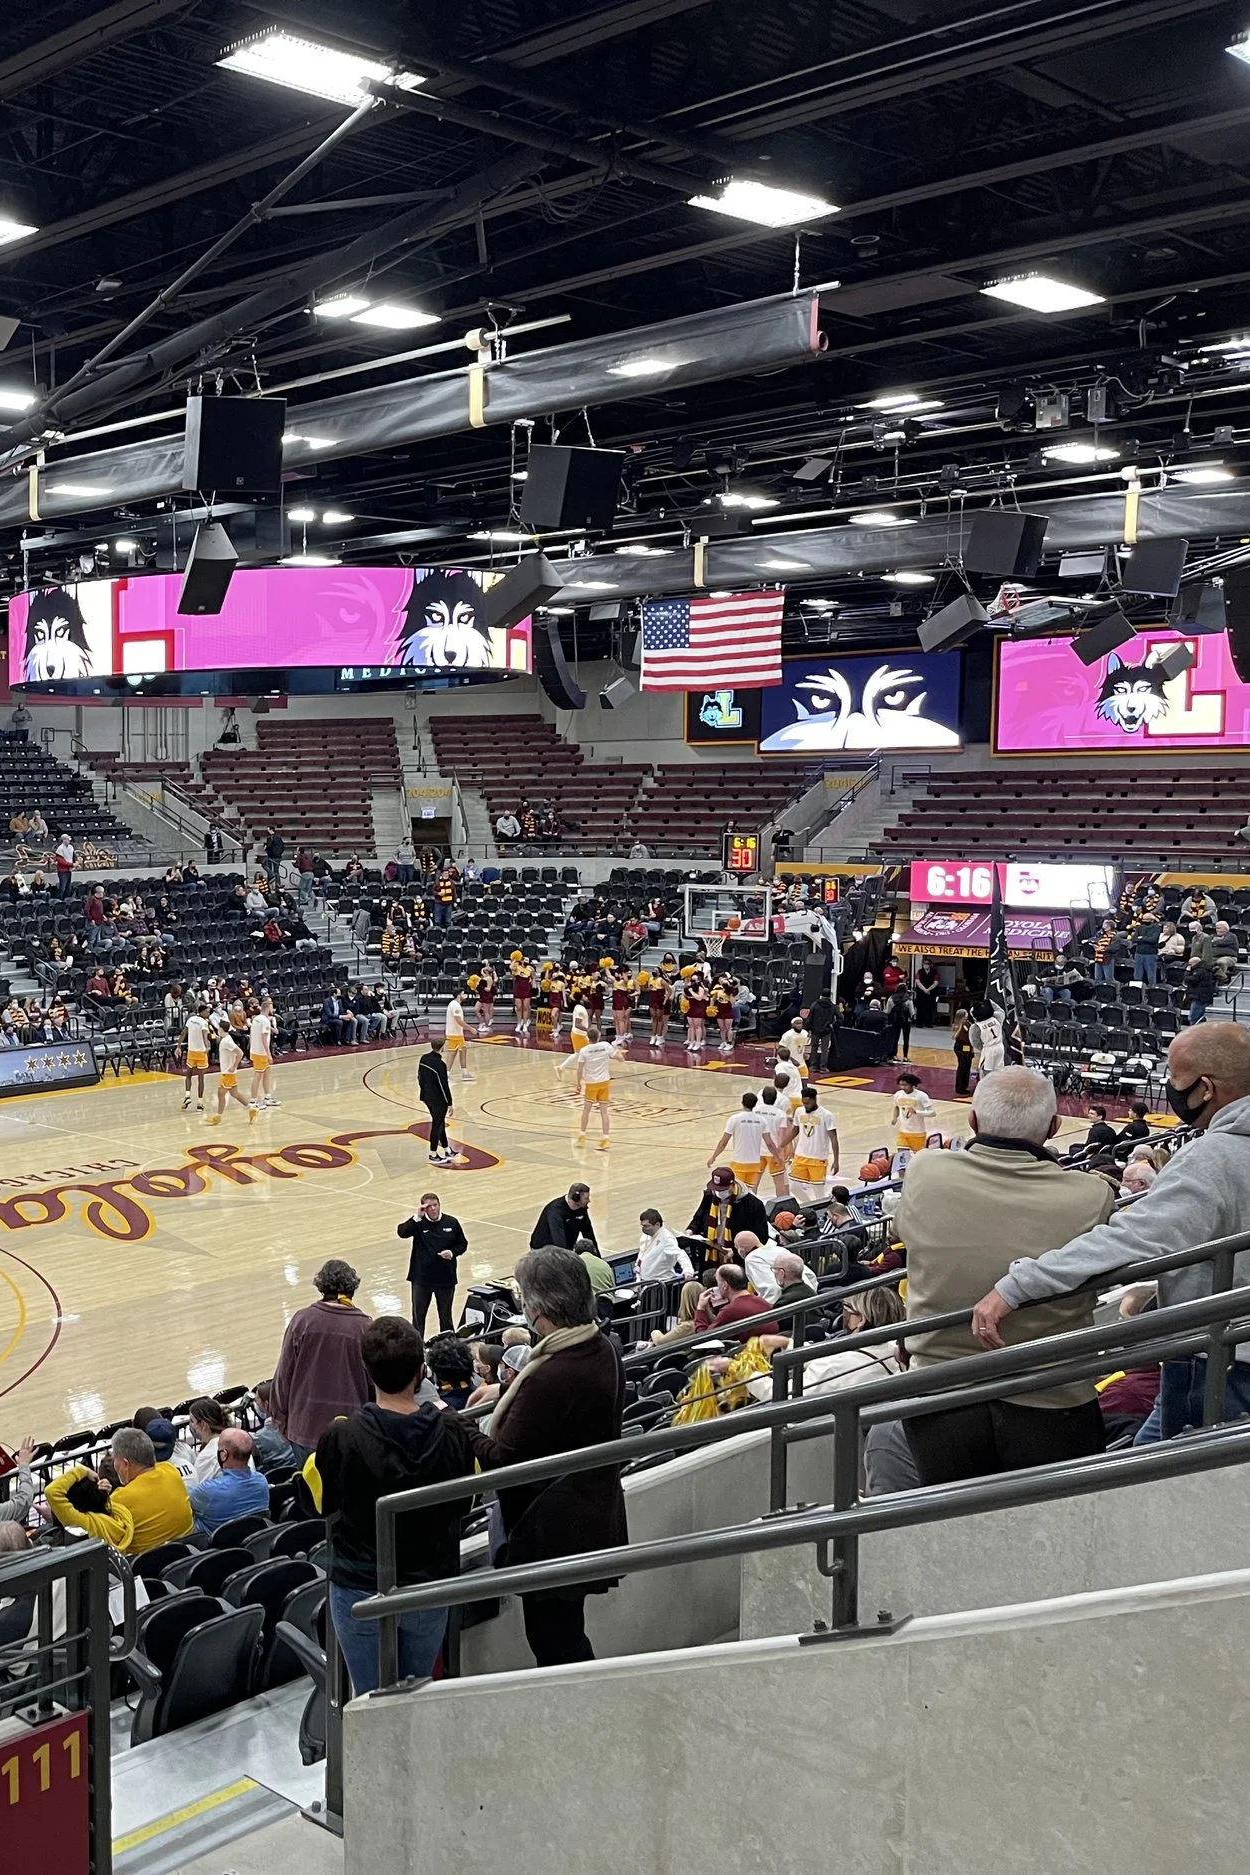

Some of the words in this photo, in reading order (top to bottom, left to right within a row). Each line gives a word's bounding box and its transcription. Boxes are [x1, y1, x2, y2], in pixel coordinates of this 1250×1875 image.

[732, 849, 753, 868] 30
[926, 865, 991, 898] 6:16
[899, 945, 912, 953] WE
[913, 945, 936, 954] ALSO
[939, 946, 963, 955] TREAT
[967, 948, 981, 956] THE
[990, 1027, 997, 1040] 1
[1, 1730, 81, 1806] 111
